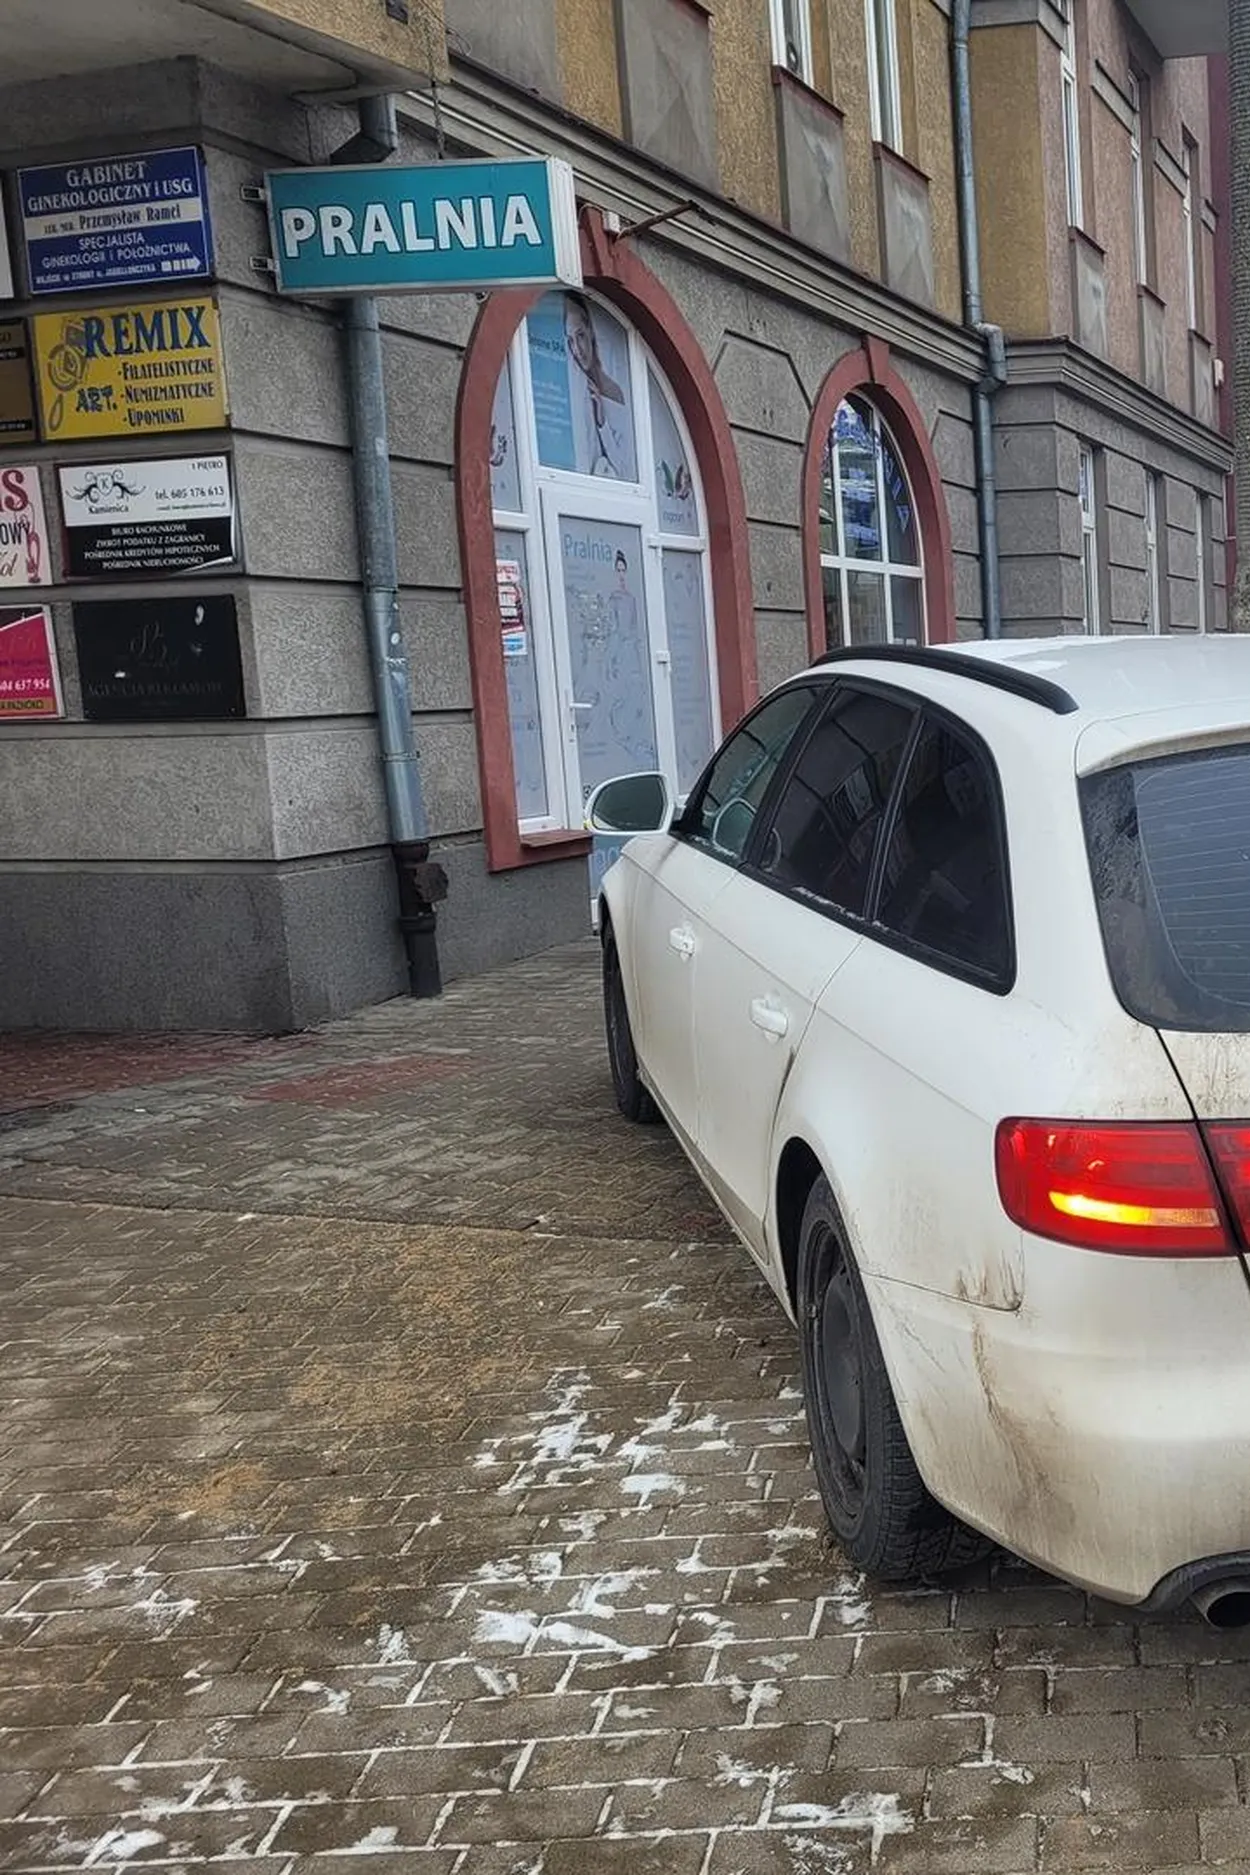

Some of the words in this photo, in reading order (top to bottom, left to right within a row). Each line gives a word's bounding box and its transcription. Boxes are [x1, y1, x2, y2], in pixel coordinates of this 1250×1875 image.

[66, 161, 147, 188] GABINET
[27, 182, 151, 213] GINEKOLOGICZNY
[163, 178, 194, 196] USG
[280, 193, 543, 259] PRALNIA
[78, 232, 145, 250] SPECJALISTA
[81, 306, 212, 359] REMIX
[76, 385, 118, 413] ART.
[208, 485, 224, 497] 613
[563, 533, 613, 562] Pralnia
